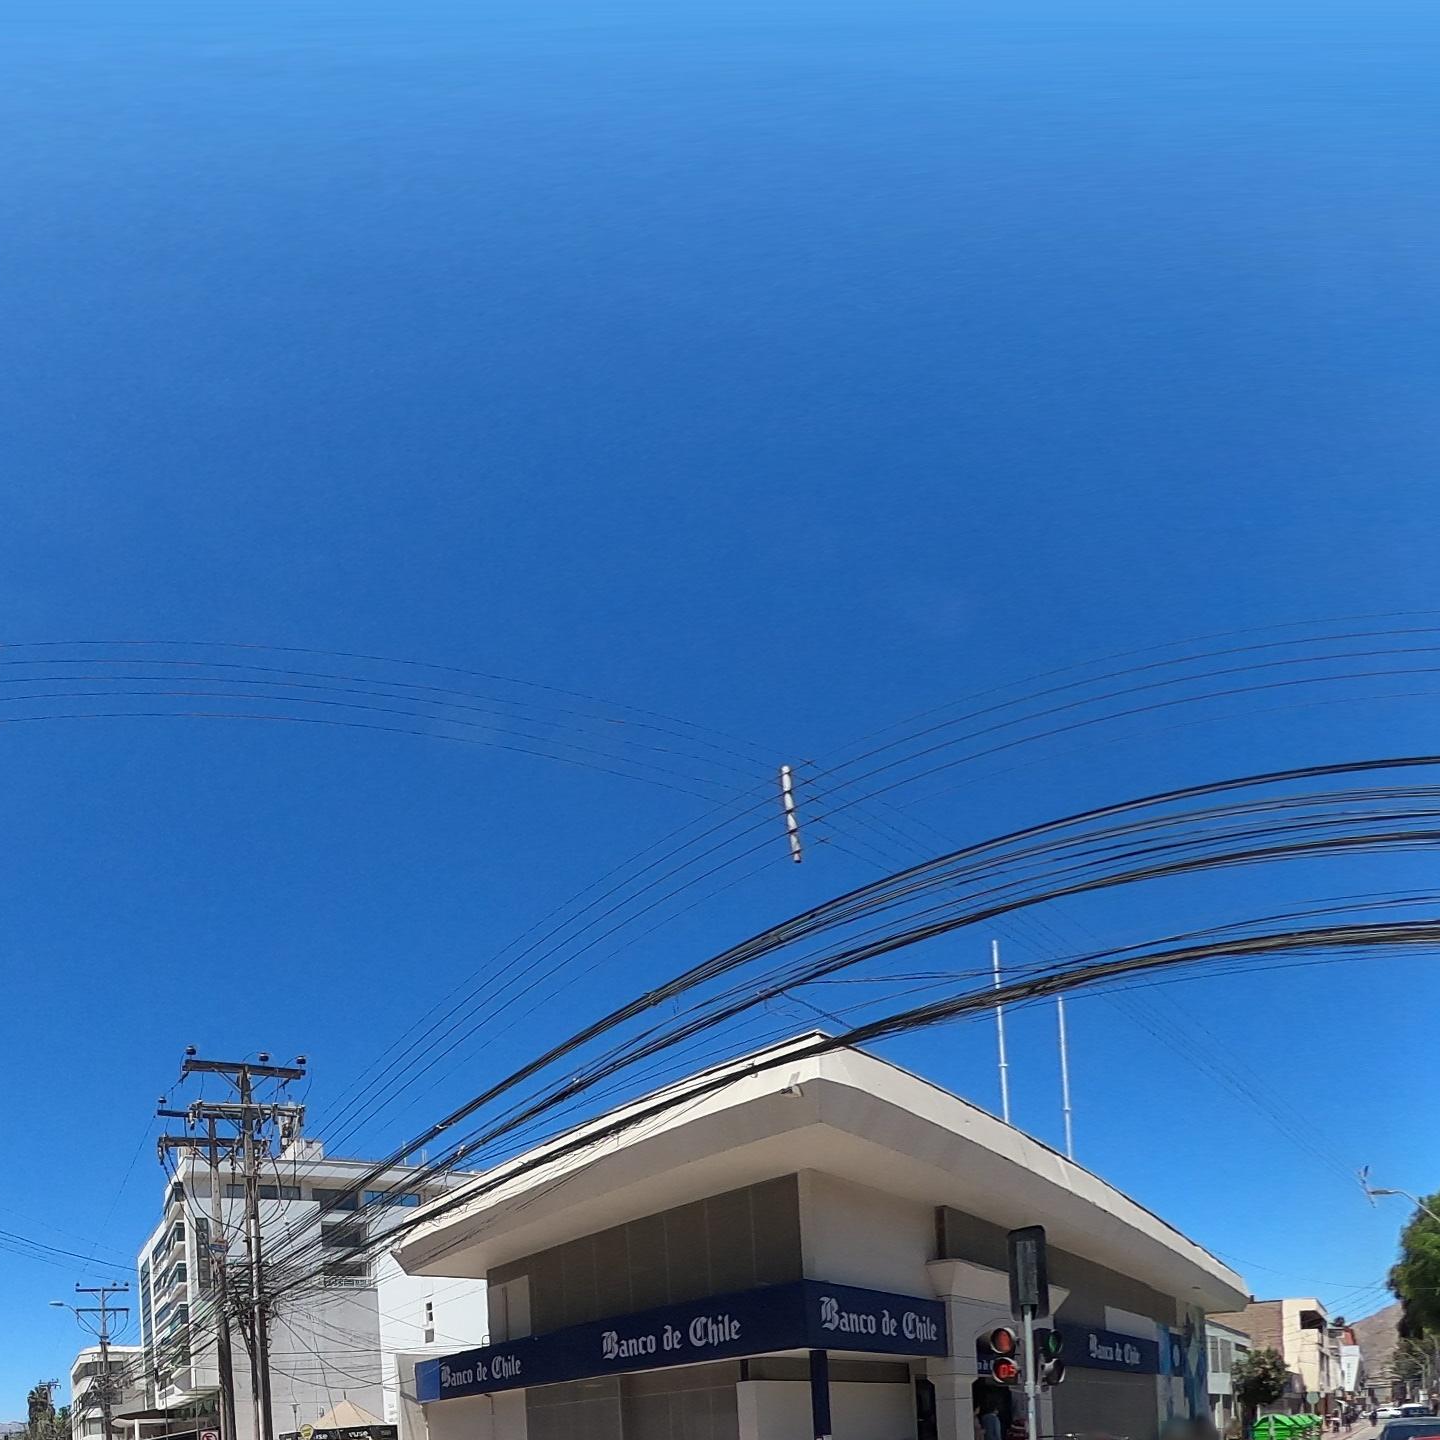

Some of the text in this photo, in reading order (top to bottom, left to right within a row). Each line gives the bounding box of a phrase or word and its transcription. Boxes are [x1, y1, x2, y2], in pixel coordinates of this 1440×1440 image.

[601, 1314, 741, 1360] Banco de Chile
[819, 1296, 938, 1342] Banco de Chile
[440, 1354, 522, 1387] Banco de Chile
